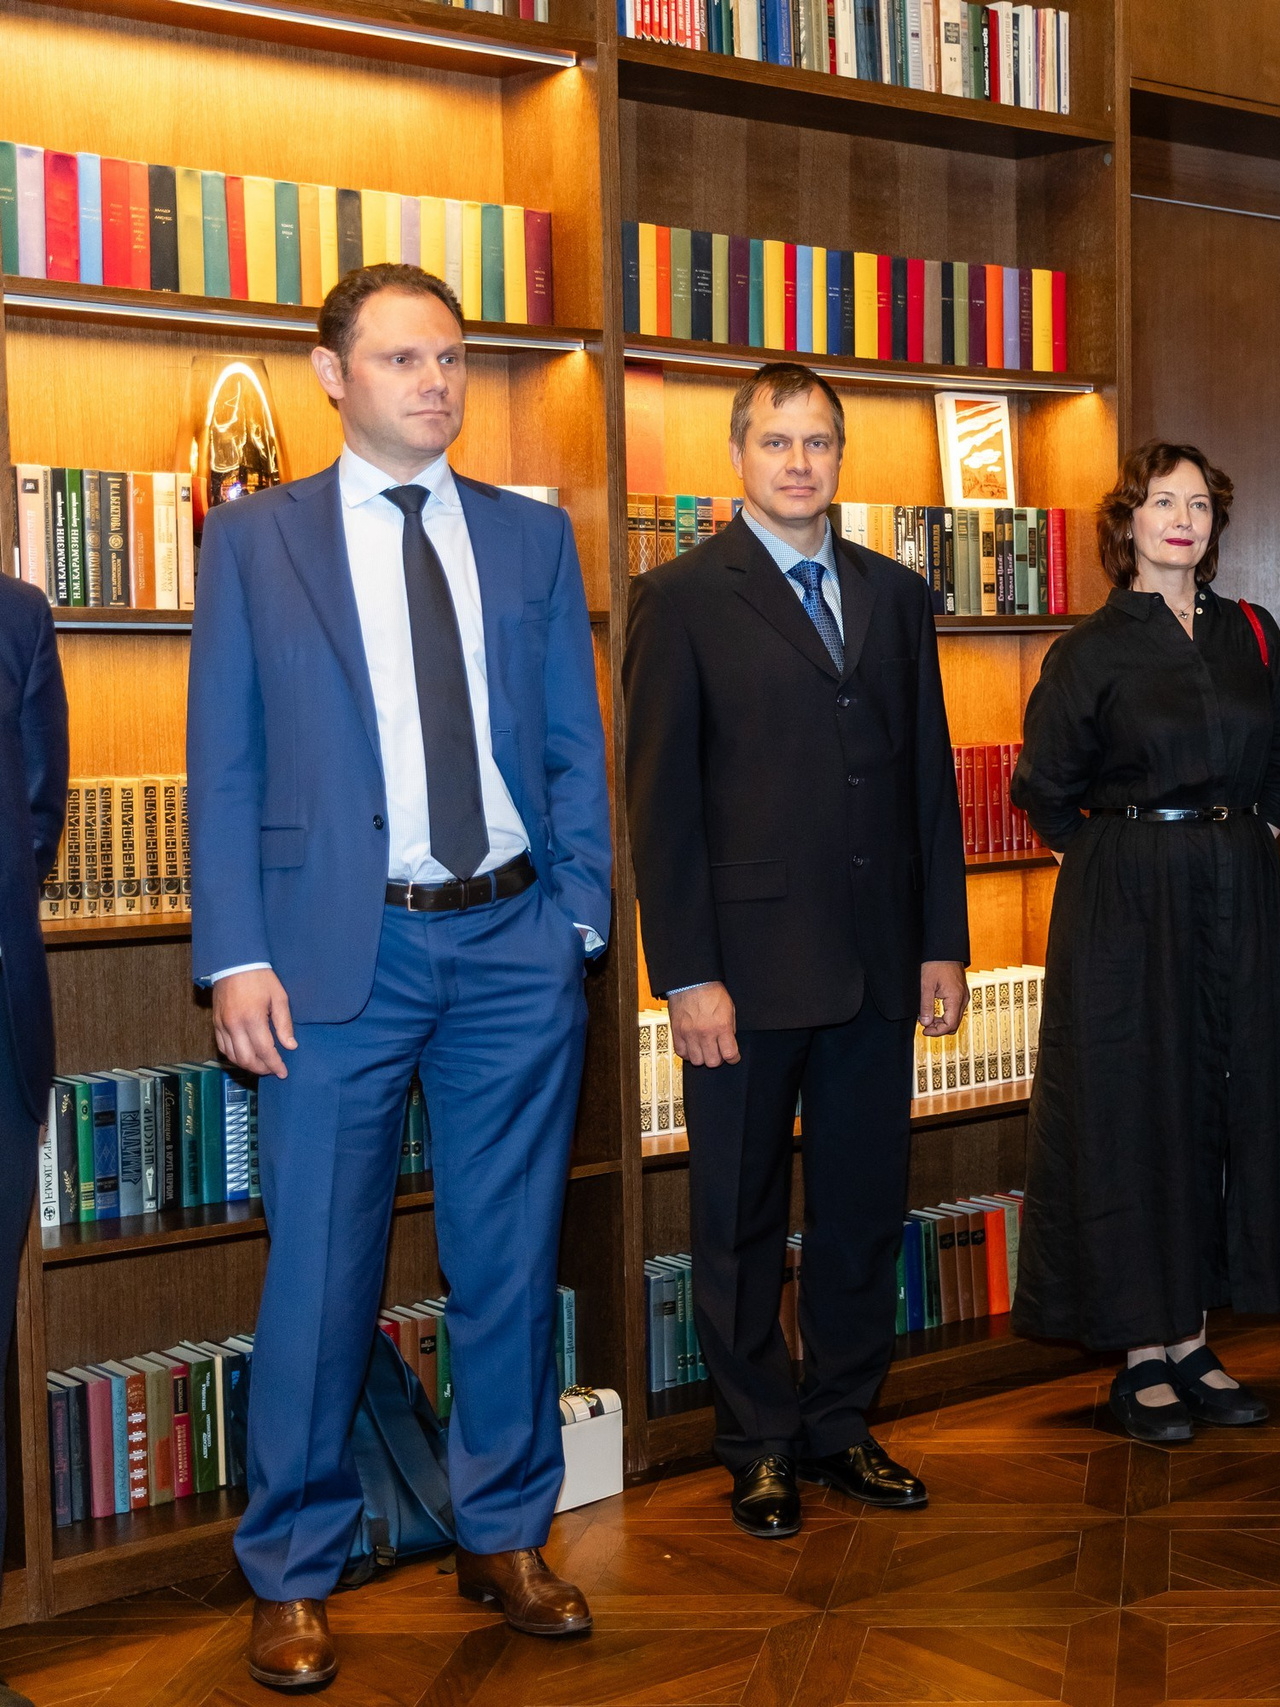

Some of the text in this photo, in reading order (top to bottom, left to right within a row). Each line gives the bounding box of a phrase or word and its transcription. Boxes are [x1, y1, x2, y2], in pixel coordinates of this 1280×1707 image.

[67, 791, 81, 898] СТЕНДАЛЬ
[84, 791, 99, 897] СТЕНДАЛЬ
[100, 790, 114, 896] СТЕНДАЛЬ
[121, 789, 138, 896] СТЕНДАЛЬ
[144, 787, 160, 894] СТЕНДАЛЬ
[164, 787, 179, 893] СТЕНДАЛЬ
[44, 1138, 53, 1160] ТРИ
[144, 1108, 154, 1165] ШЕКСПИР
[165, 1151, 174, 1171] КРУГЕ
[165, 1172, 174, 1199] ПЕРВОМ
